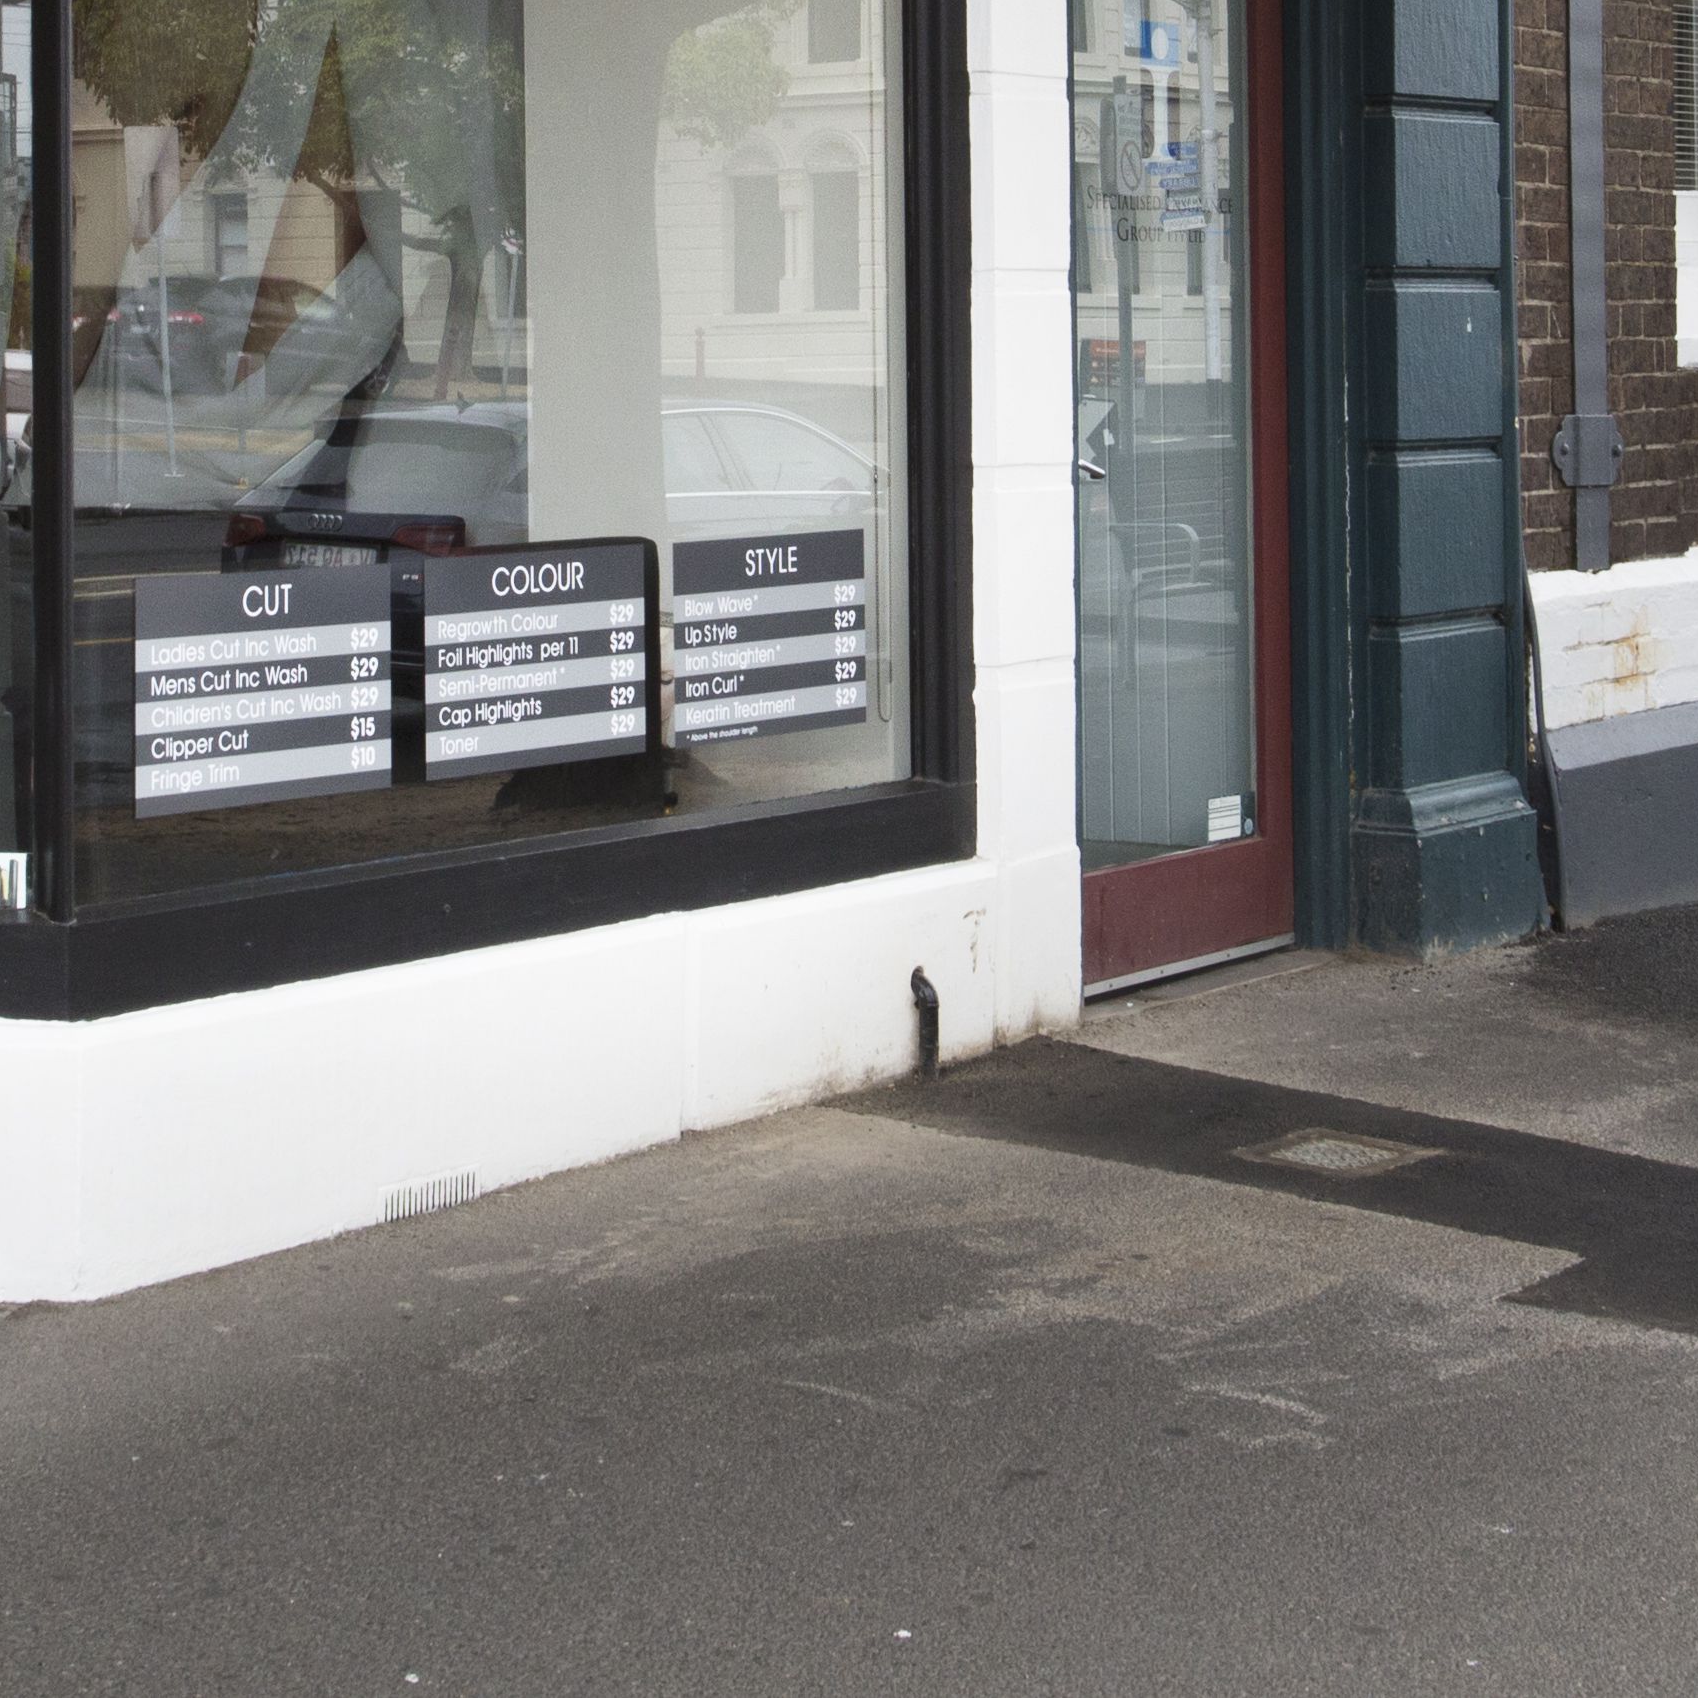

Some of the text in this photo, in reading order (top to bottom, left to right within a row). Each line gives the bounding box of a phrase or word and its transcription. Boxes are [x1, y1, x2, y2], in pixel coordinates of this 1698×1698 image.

[1165, 190, 1233, 214] IANCE
[491, 561, 584, 596] COLOUR
[745, 546, 798, 576] STYLE
[242, 583, 292, 617] CUT
[684, 599, 713, 617] Blow
[834, 584, 856, 605] $29
[438, 604, 634, 642] Regrowth Colour $29
[685, 609, 856, 646] Up Style $29
[151, 627, 379, 665] Ladies Cut Inc Wash $29
[438, 631, 635, 669] Foil Highlights per 11 $29
[685, 654, 709, 671] Iron
[835, 635, 856, 656] $29
[151, 656, 379, 696] Mens Cut Inc Wash $29
[610, 658, 635, 681] $29
[685, 680, 709, 698] Iron
[835, 661, 857, 682] $29
[151, 686, 379, 728] Children's Cut Inc Wash $29
[438, 686, 635, 728] Cap Highlights $29
[685, 687, 857, 725] Keratin Treatment $29
[151, 716, 376, 761] Clipper Cut $15
[439, 714, 635, 755] Toner $29
[151, 746, 376, 792] Fringe Trim $10
